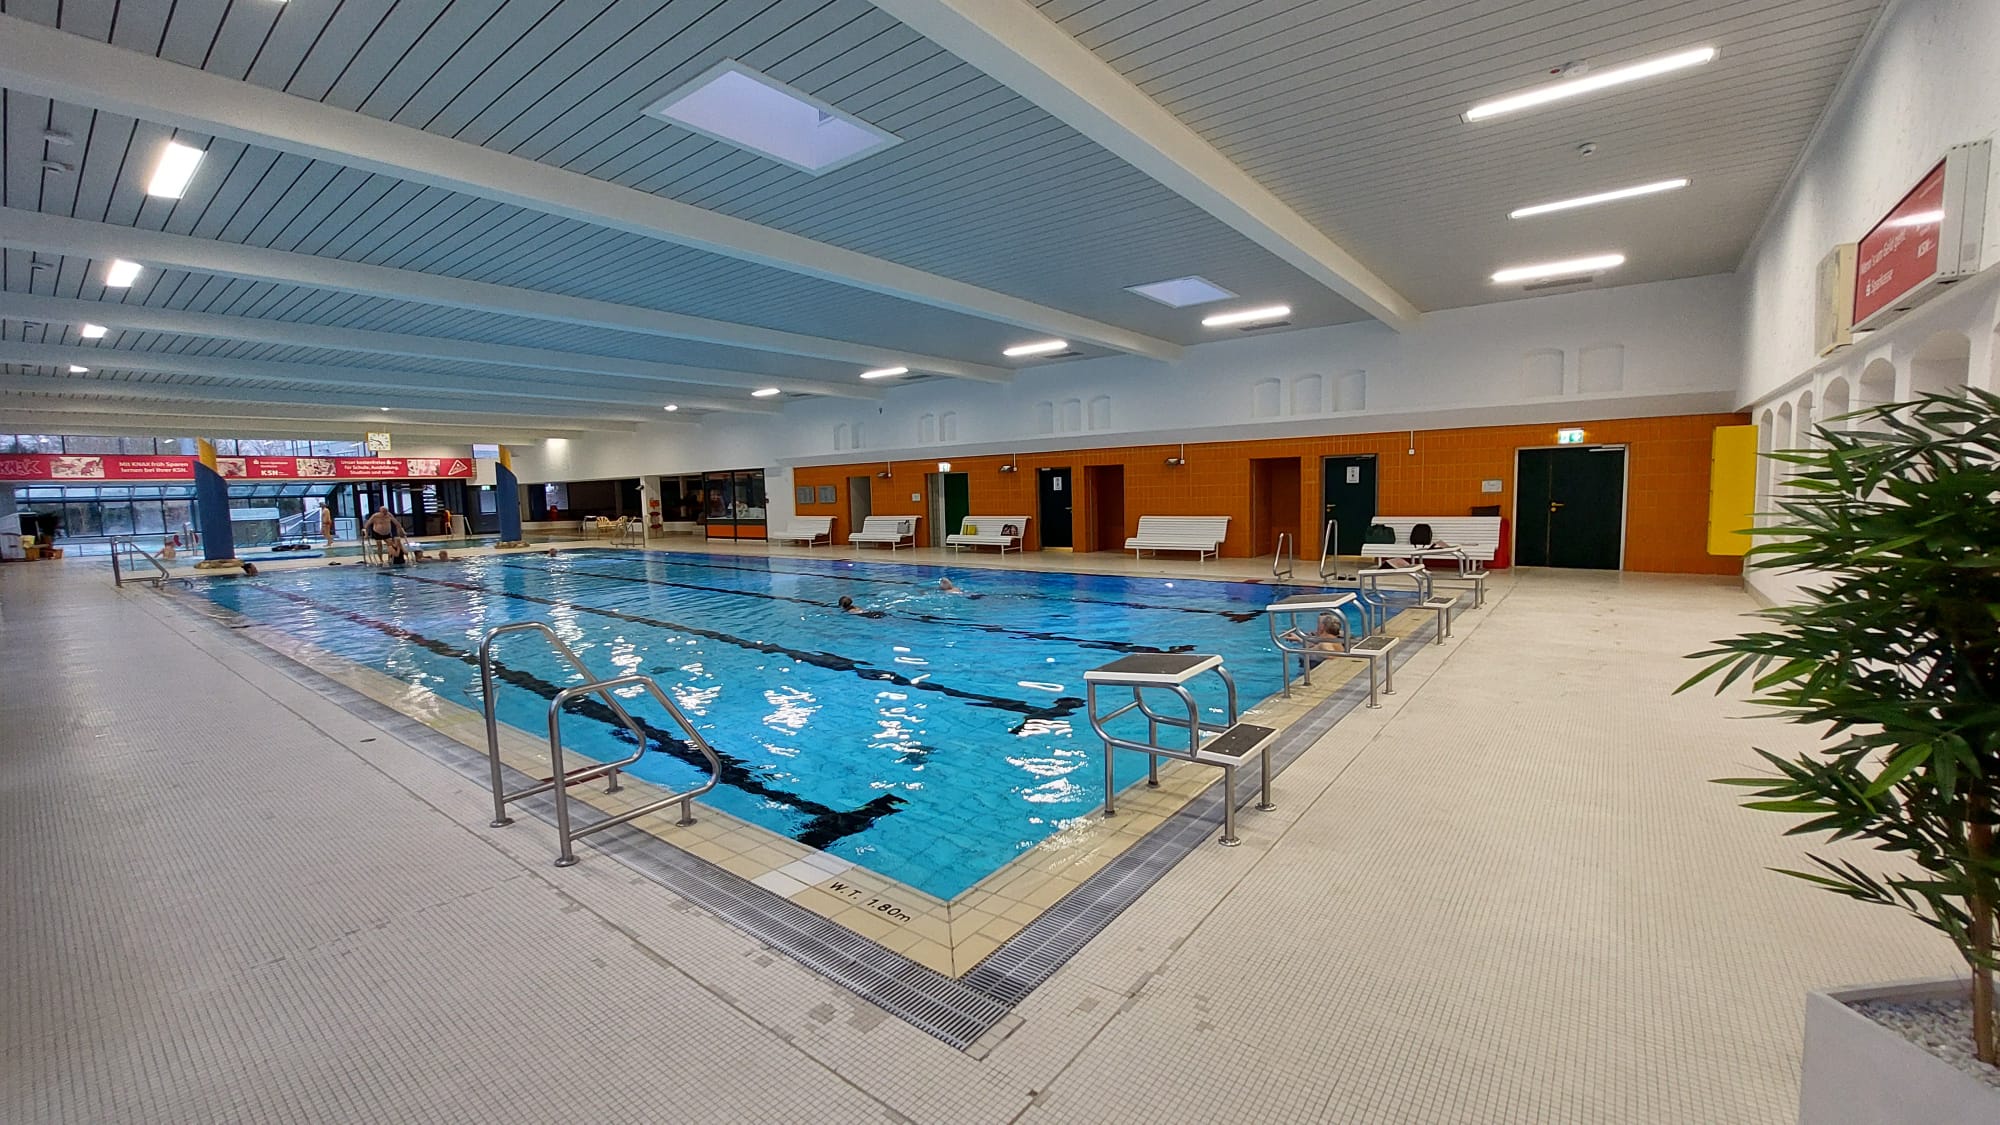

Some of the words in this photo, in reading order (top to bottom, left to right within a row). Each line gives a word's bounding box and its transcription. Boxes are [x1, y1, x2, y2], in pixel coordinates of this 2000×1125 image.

[830, 881, 849, 894] W.
[847, 889, 863, 900] T.
[867, 898, 911, 923] 1.80m
